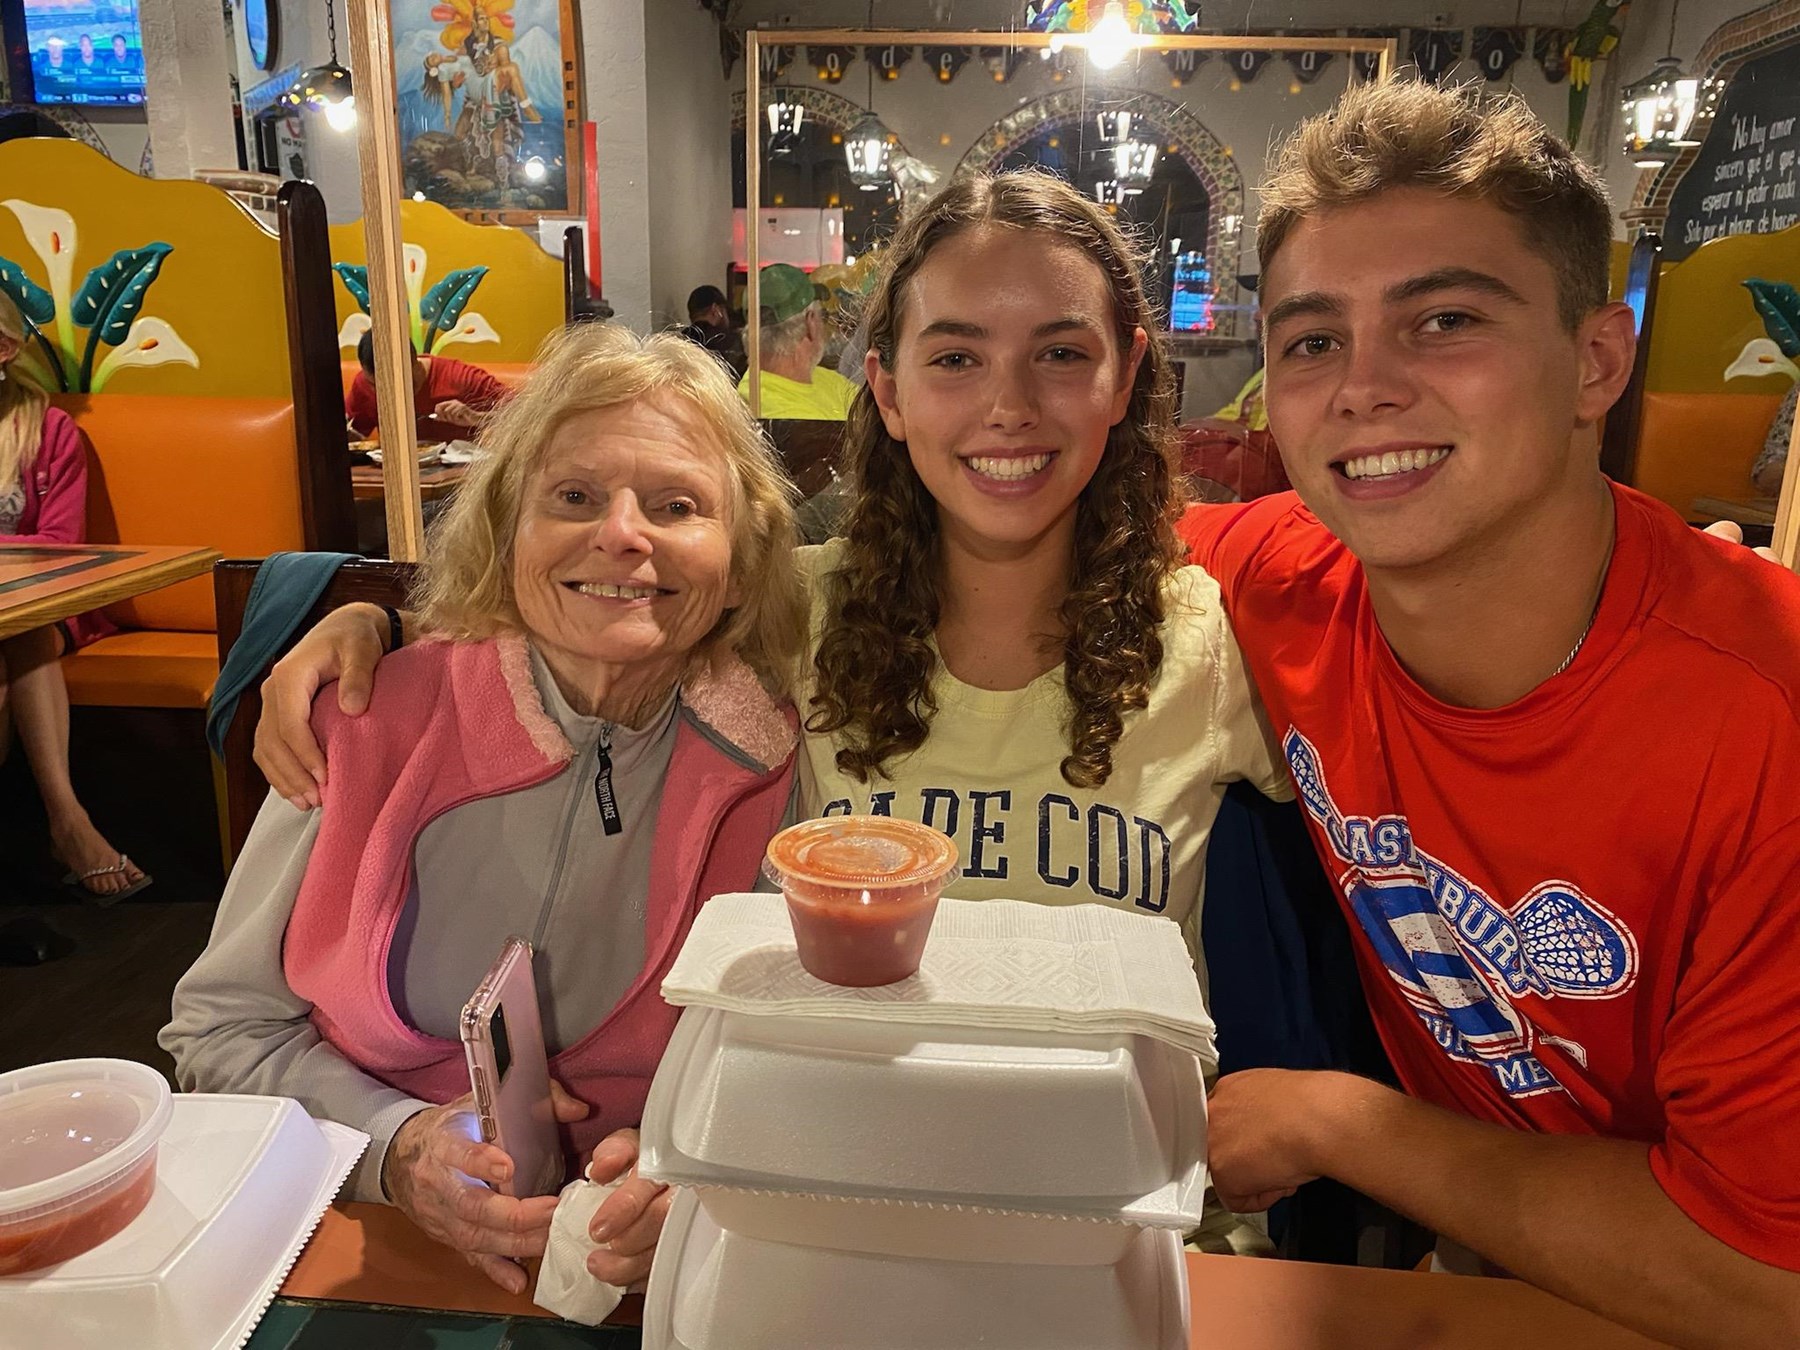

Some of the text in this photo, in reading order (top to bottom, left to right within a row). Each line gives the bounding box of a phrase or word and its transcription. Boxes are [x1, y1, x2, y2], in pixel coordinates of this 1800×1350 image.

[1769, 117, 1796, 140] amor
[1714, 159, 1745, 182] sincero
[1747, 156, 1761, 183] que
[1772, 170, 1796, 201] nada
[1036, 792, 1172, 913] COD
